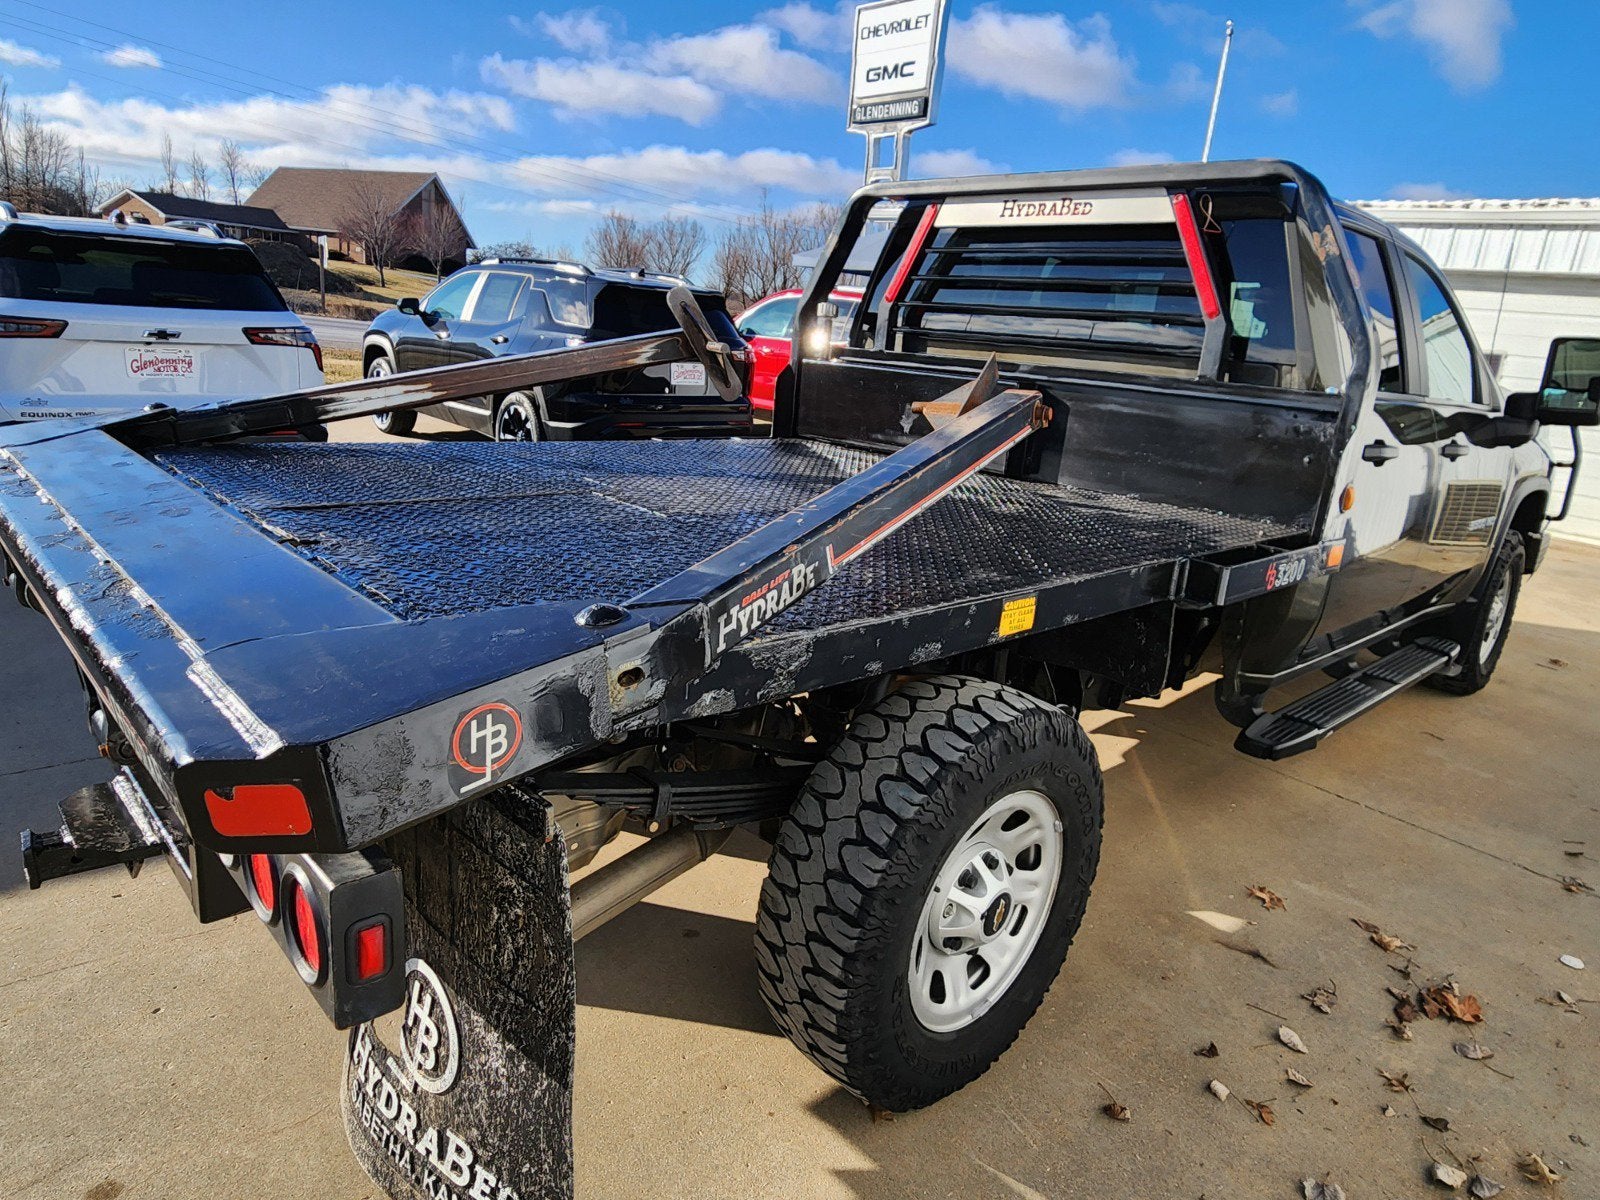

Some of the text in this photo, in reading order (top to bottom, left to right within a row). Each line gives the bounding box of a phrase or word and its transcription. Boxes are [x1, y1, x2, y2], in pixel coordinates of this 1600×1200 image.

[860, 13, 931, 40] CHEVROLET
[866, 61, 916, 82] GMC
[855, 99, 919, 120] GLENDENNING
[130, 353, 193, 374] Glendenning
[1004, 597, 1036, 610] CAUTION
